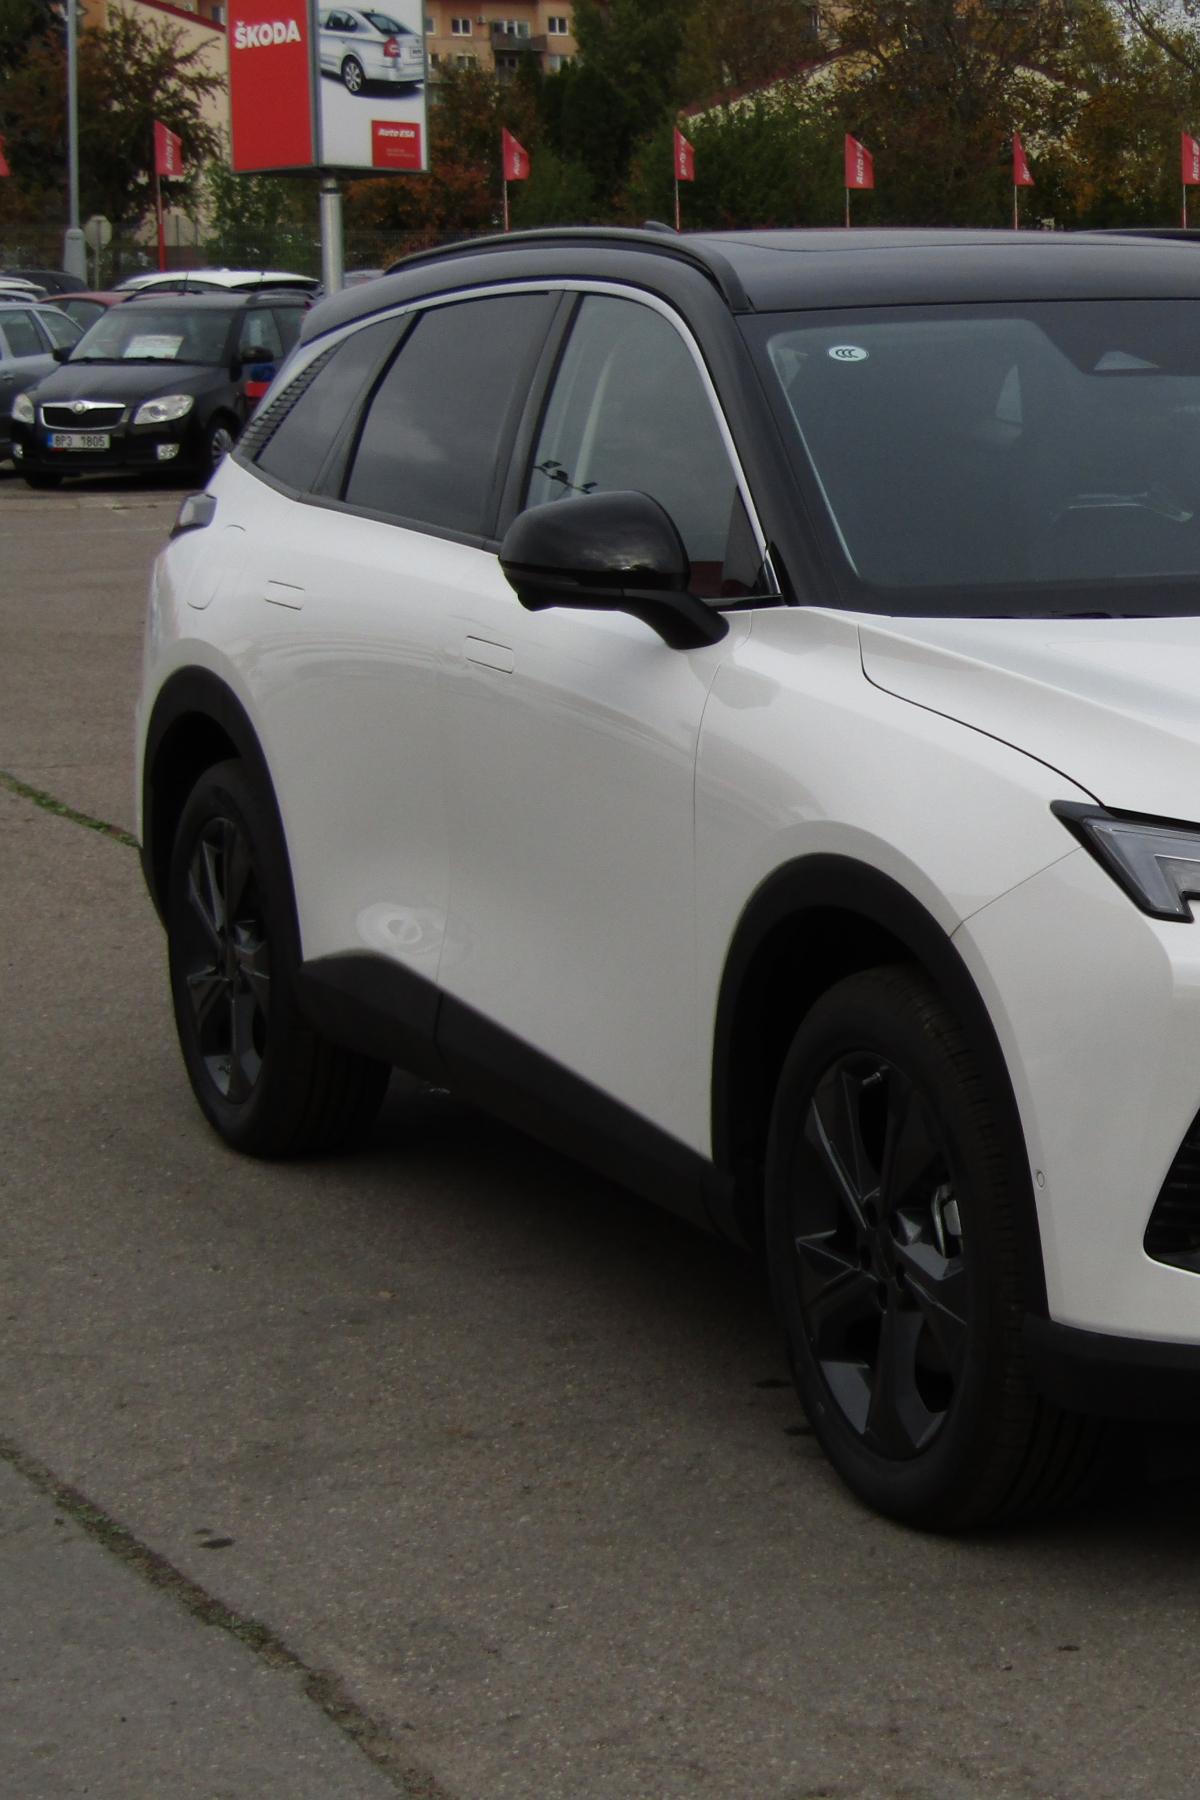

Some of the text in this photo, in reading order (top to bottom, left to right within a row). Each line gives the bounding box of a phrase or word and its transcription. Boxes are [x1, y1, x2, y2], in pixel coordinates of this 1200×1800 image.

[234, 20, 301, 49] ŠKODA
[378, 128, 416, 139] Auto ESA
